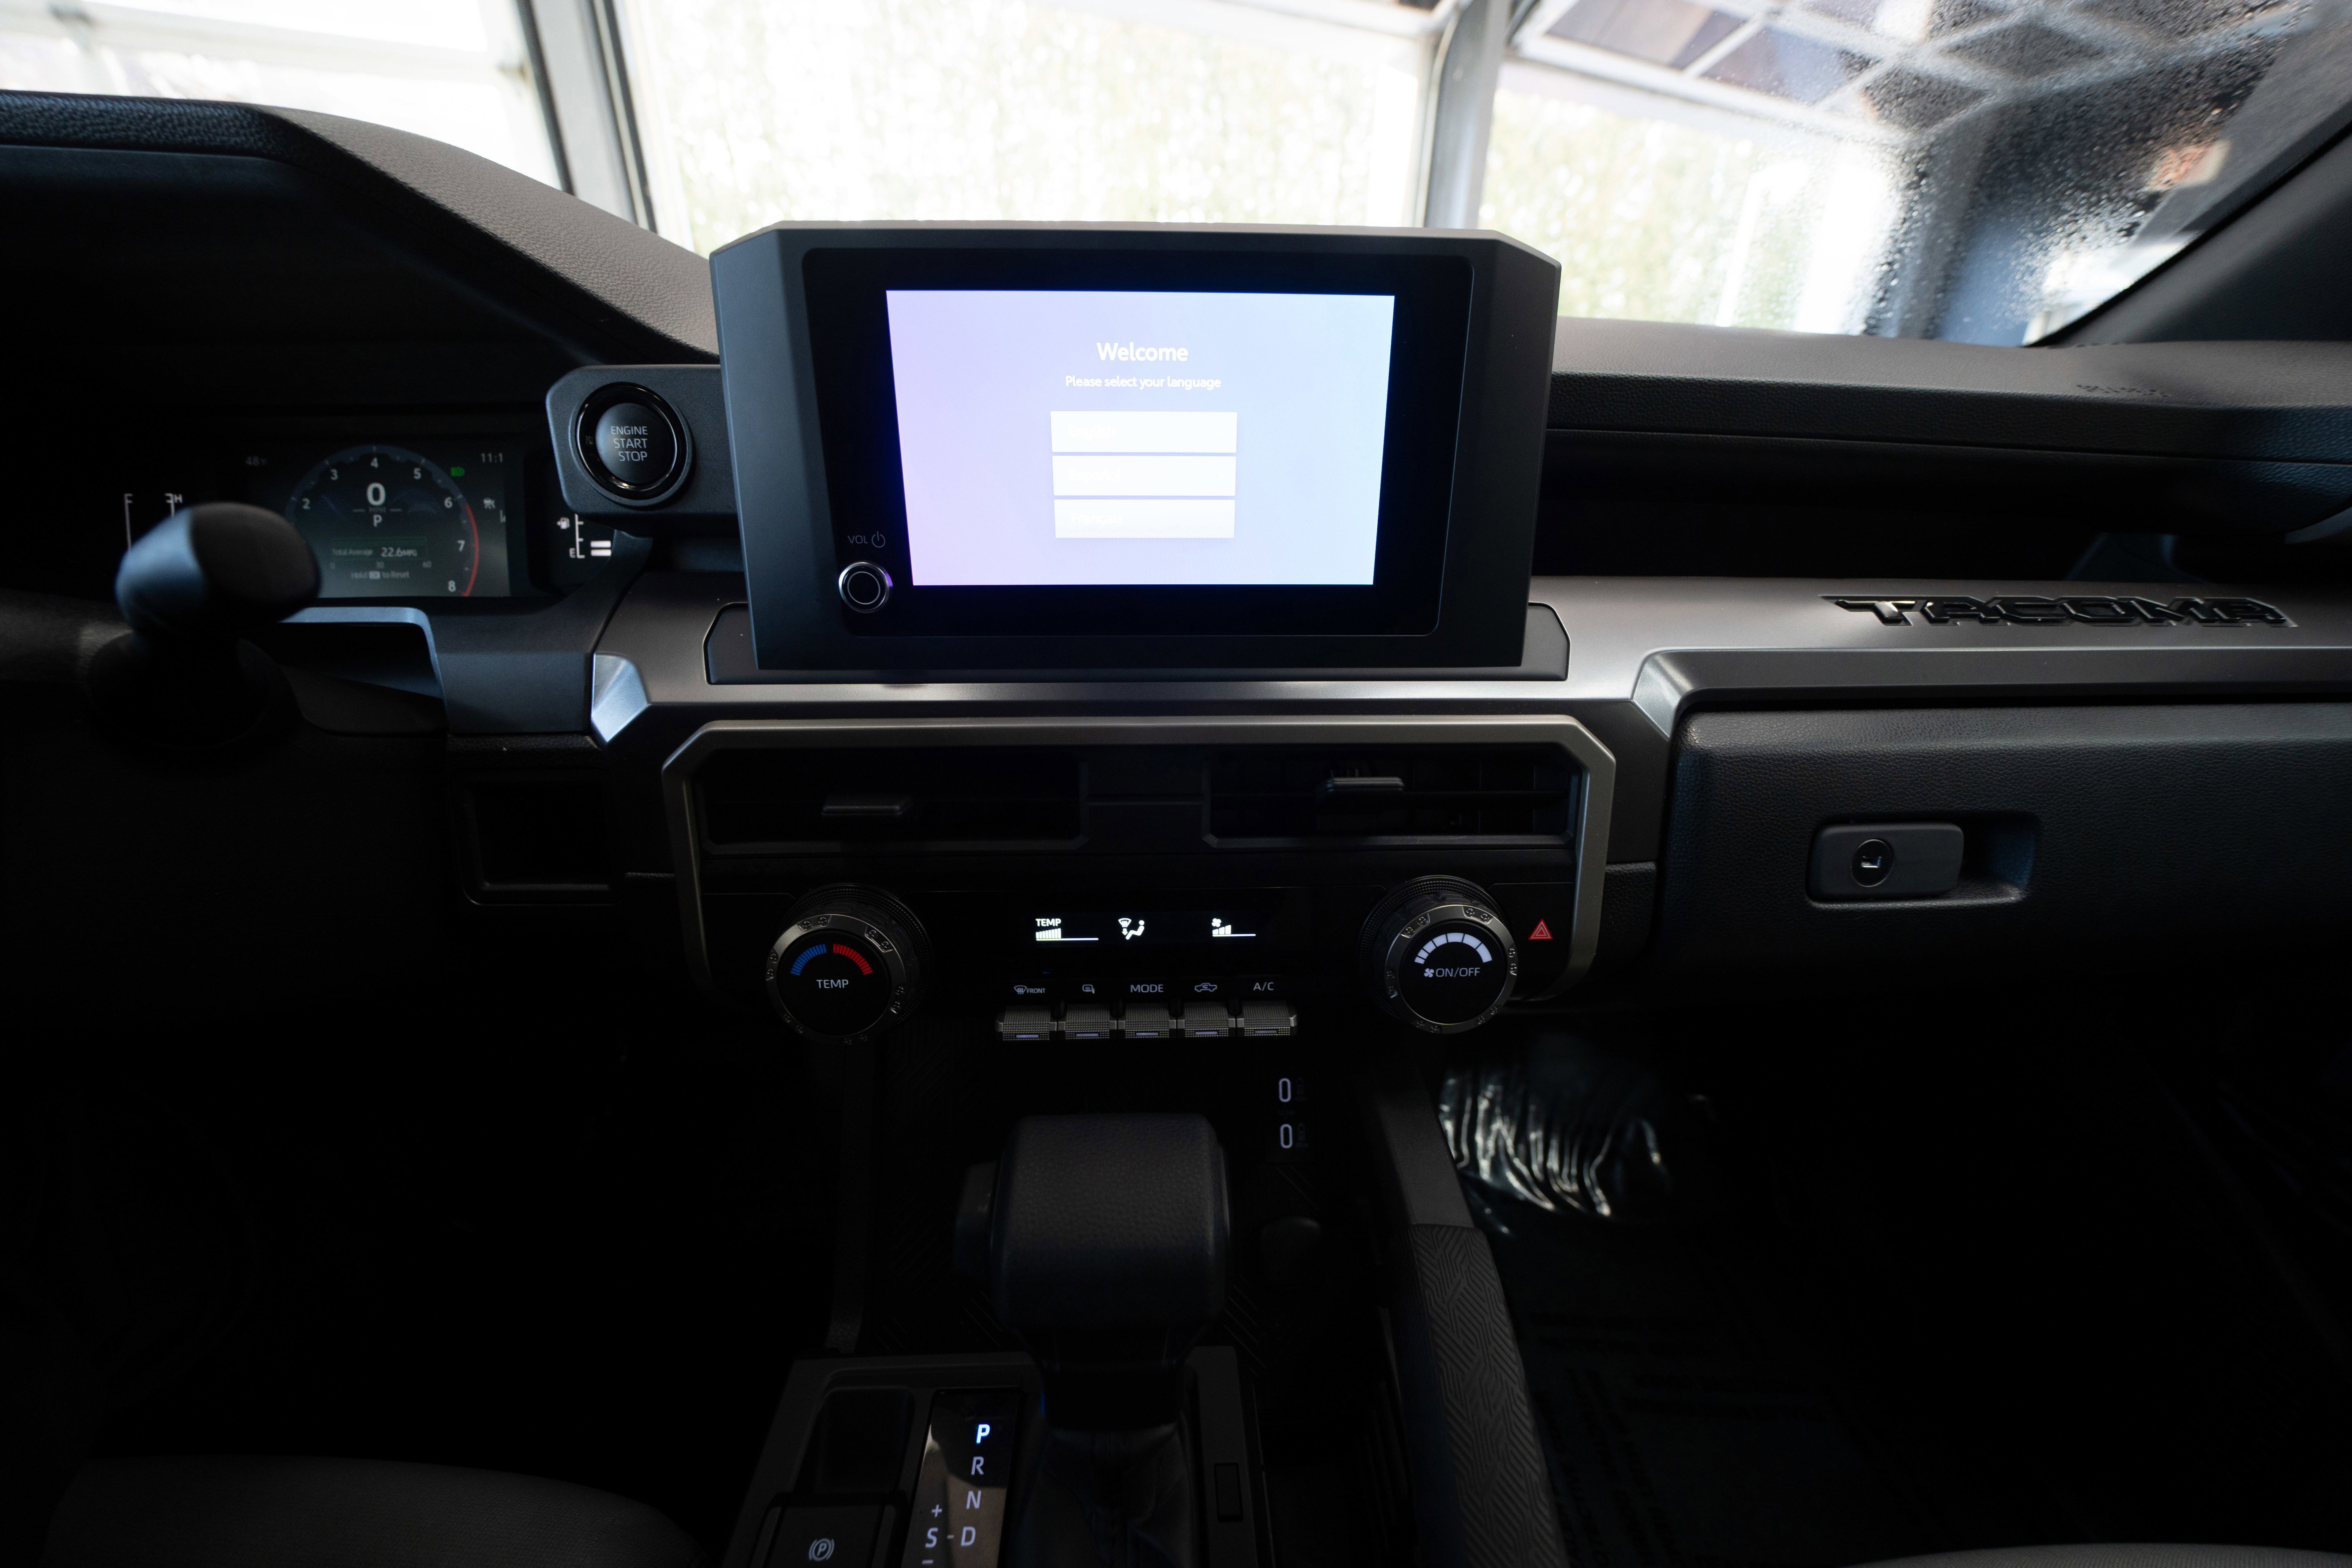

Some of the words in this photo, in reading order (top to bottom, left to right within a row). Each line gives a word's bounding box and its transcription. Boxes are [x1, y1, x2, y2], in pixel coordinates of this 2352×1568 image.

[1096, 342, 1189, 362] Welcome
[1065, 375, 1102, 388] Please
[1104, 376, 1138, 388] select
[1140, 379, 1165, 390] your
[1167, 376, 1222, 391] language
[611, 426, 648, 435] ENGINE
[613, 438, 648, 449] START
[619, 451, 648, 462] STOP
[371, 458, 379, 468] 4
[331, 469, 339, 481] 3
[414, 468, 422, 480] 5
[367, 482, 386, 506] 0
[303, 498, 311, 510] 2
[445, 497, 453, 509] 6
[373, 514, 382, 527] P
[847, 535, 869, 544] VOL
[458, 540, 466, 552] 7
[448, 581, 457, 592] 8
[1818, 595, 2298, 627] TACOMA
[1036, 918, 1062, 927] TEMP
[1436, 967, 1481, 978] ON/OFF
[816, 980, 849, 989] TEMP
[1130, 984, 1164, 993] MODE
[1253, 982, 1274, 992] A/C
[976, 1424, 991, 1445] P
[971, 1456, 984, 1476] R
[966, 1490, 982, 1510] N
[925, 1527, 939, 1548] S
[960, 1526, 976, 1547] D
